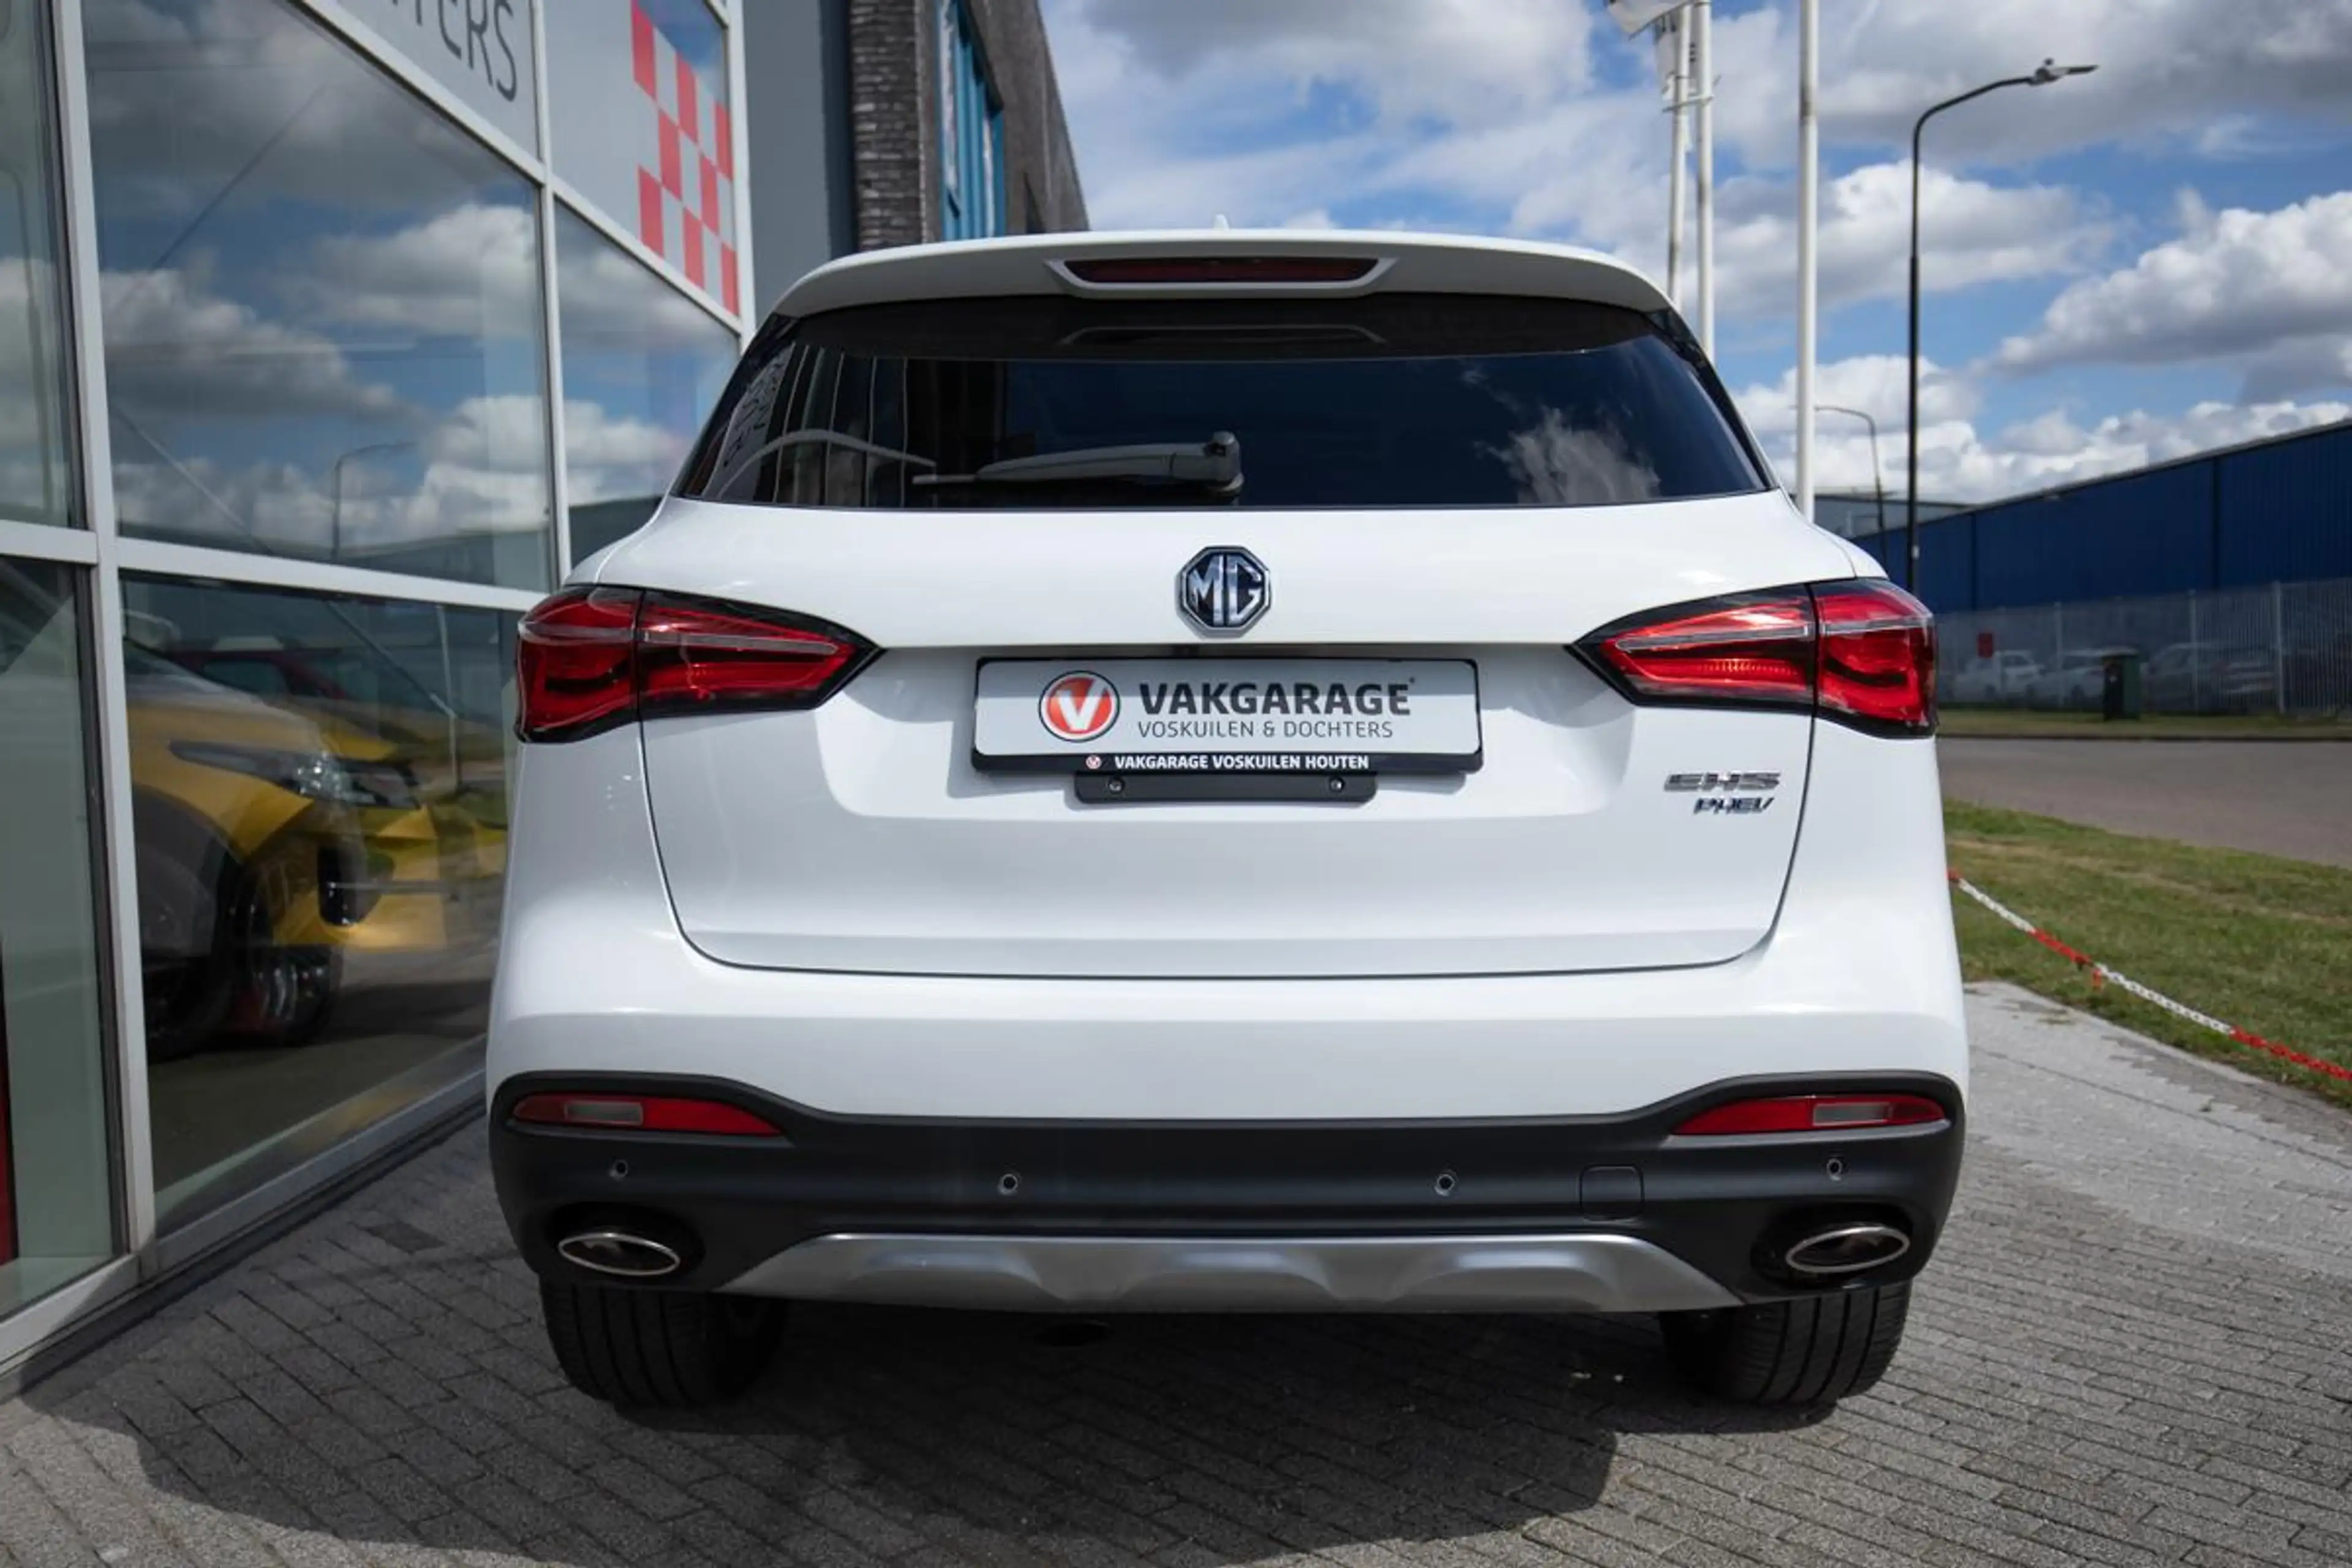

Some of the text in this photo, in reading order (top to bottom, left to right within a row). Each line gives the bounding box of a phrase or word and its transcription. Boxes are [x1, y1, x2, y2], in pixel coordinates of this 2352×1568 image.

[1187, 553, 1263, 627] MG
[1140, 682, 1411, 715] VAKGARAGE
[1139, 721, 1393, 738] VOSKUILEN & DOCHTERS
[1115, 755, 1208, 769] VAKGARAGE
[1213, 755, 1300, 769] VOSKUILEN
[1305, 755, 1370, 769] HOUTEN
[1664, 772, 1781, 791] EHS
[1693, 796, 1775, 815] PHEV
